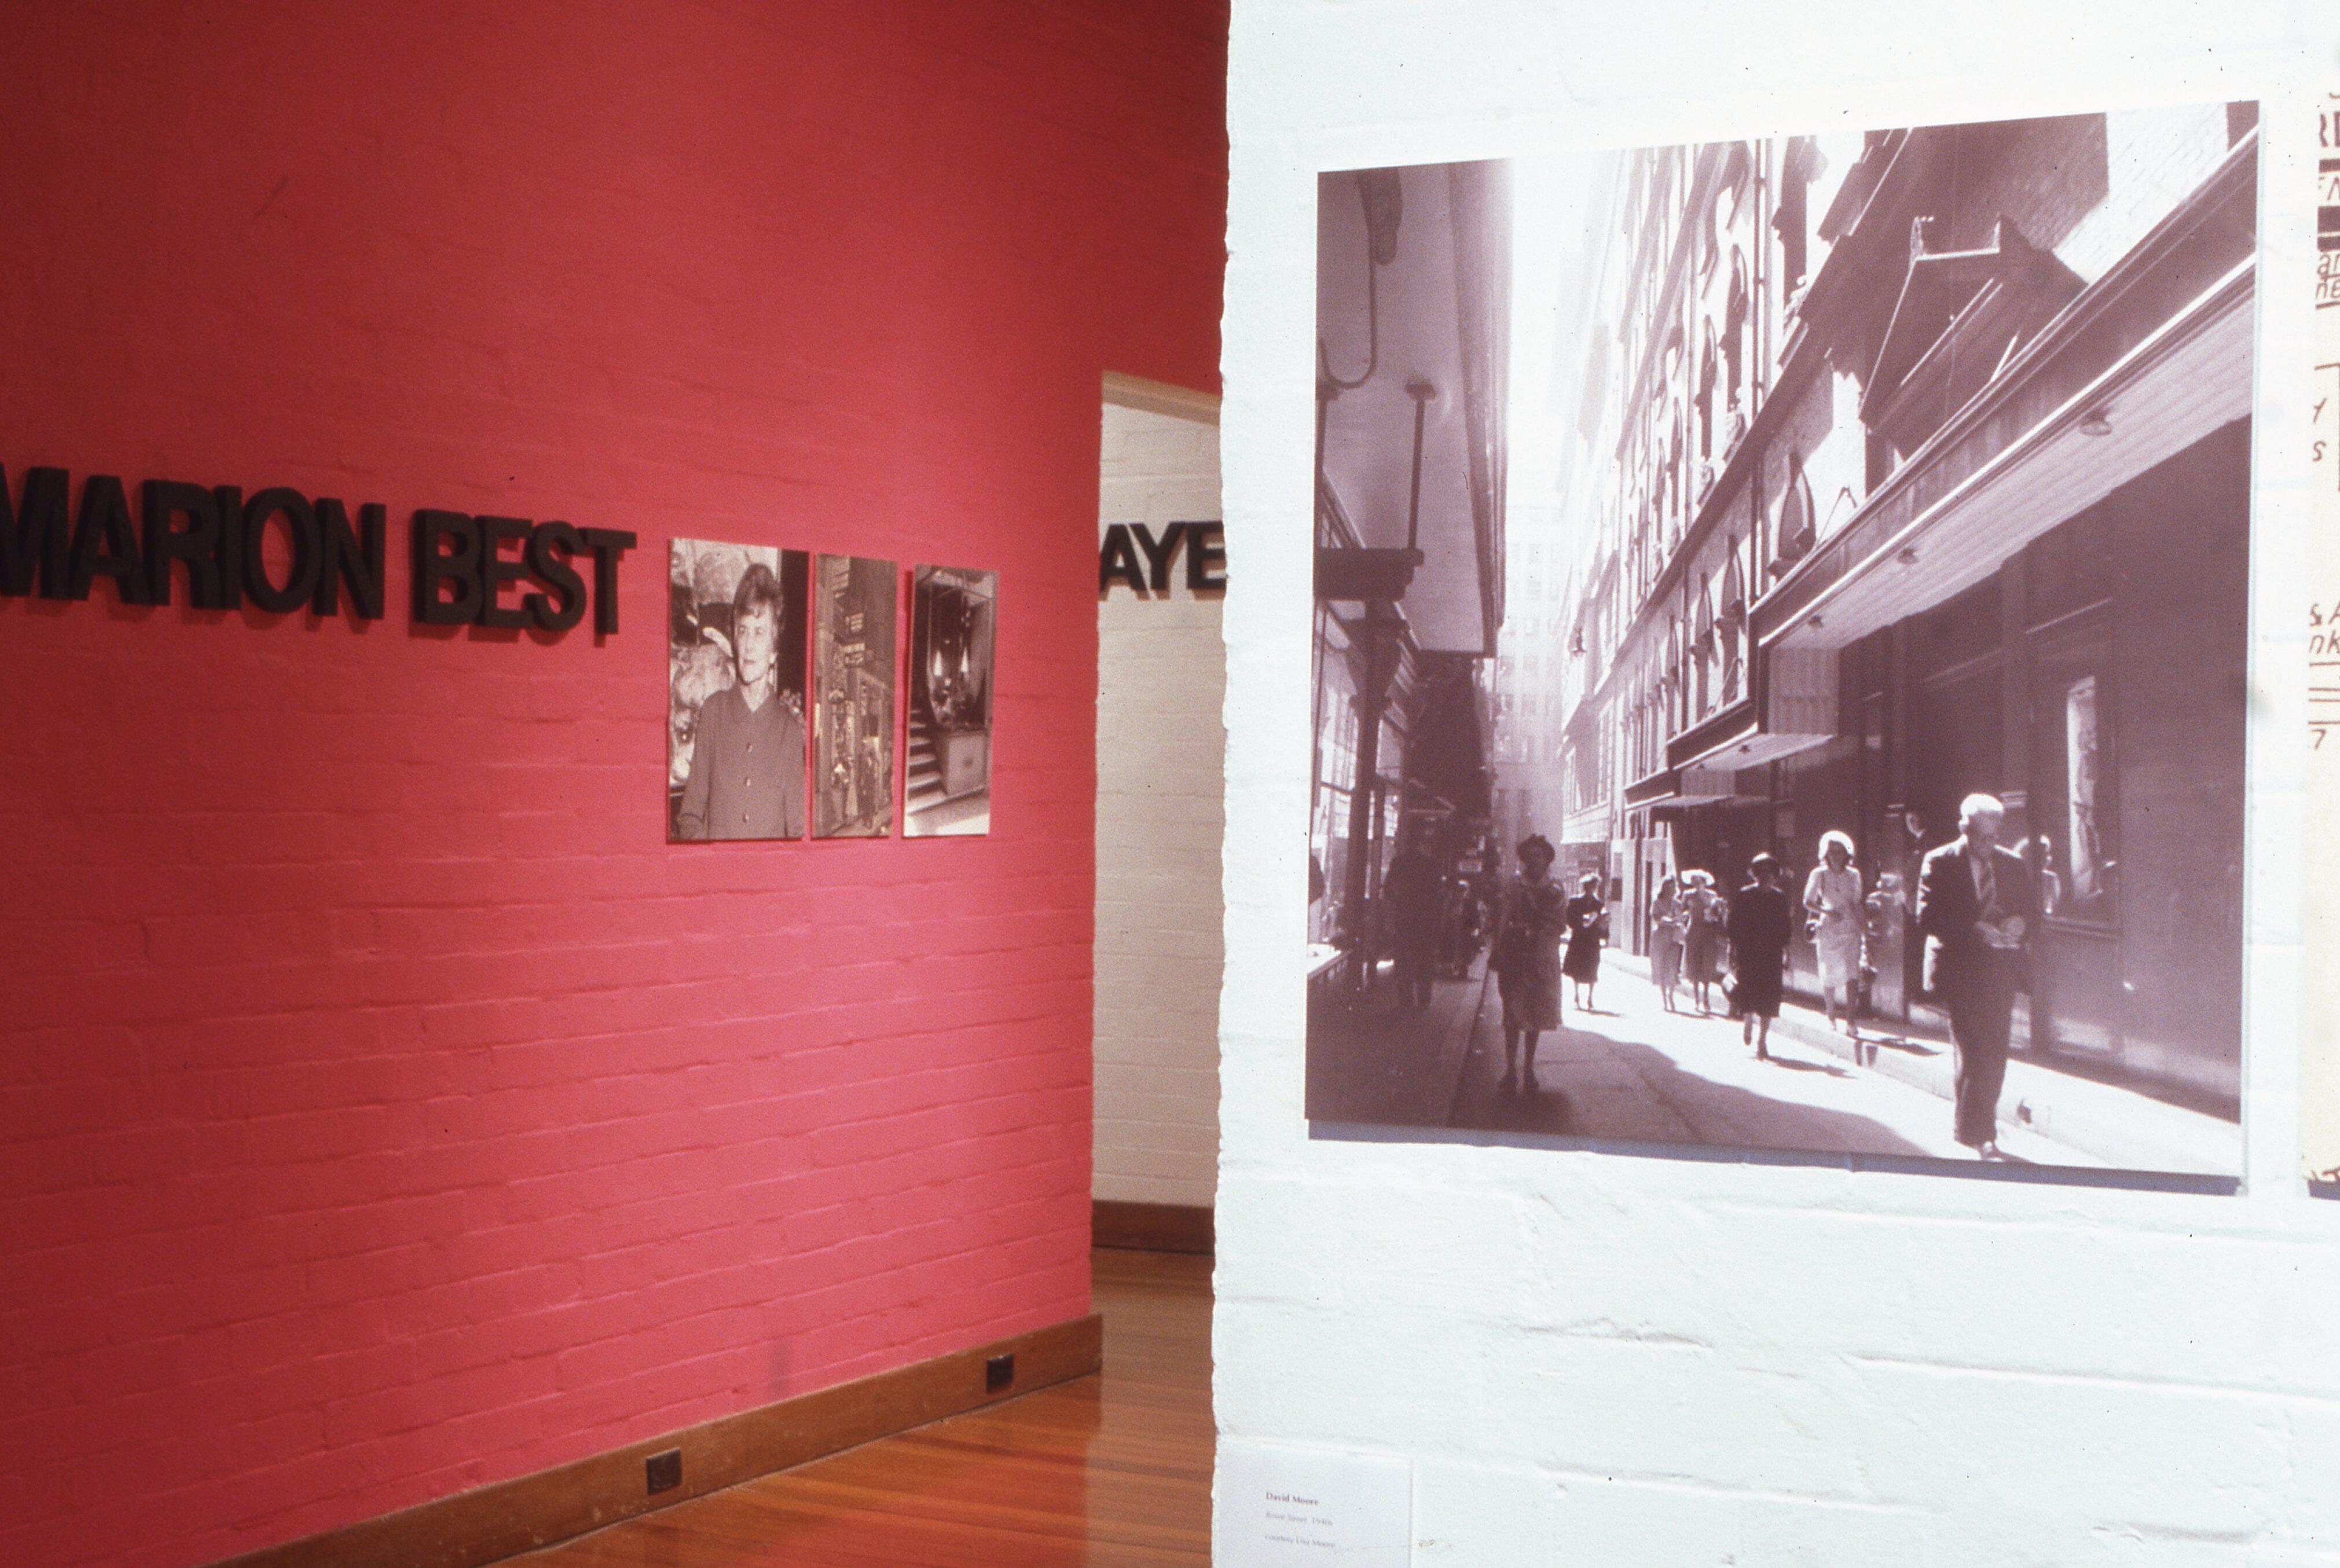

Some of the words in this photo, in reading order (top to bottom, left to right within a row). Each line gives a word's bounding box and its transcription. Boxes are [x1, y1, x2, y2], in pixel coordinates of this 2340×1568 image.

[0, 467, 387, 620] MARION
[413, 509, 637, 635] BEST
[1098, 521, 1227, 590] AYE
[1266, 1492, 1290, 1503] David
[1292, 1495, 1319, 1506] Moore
